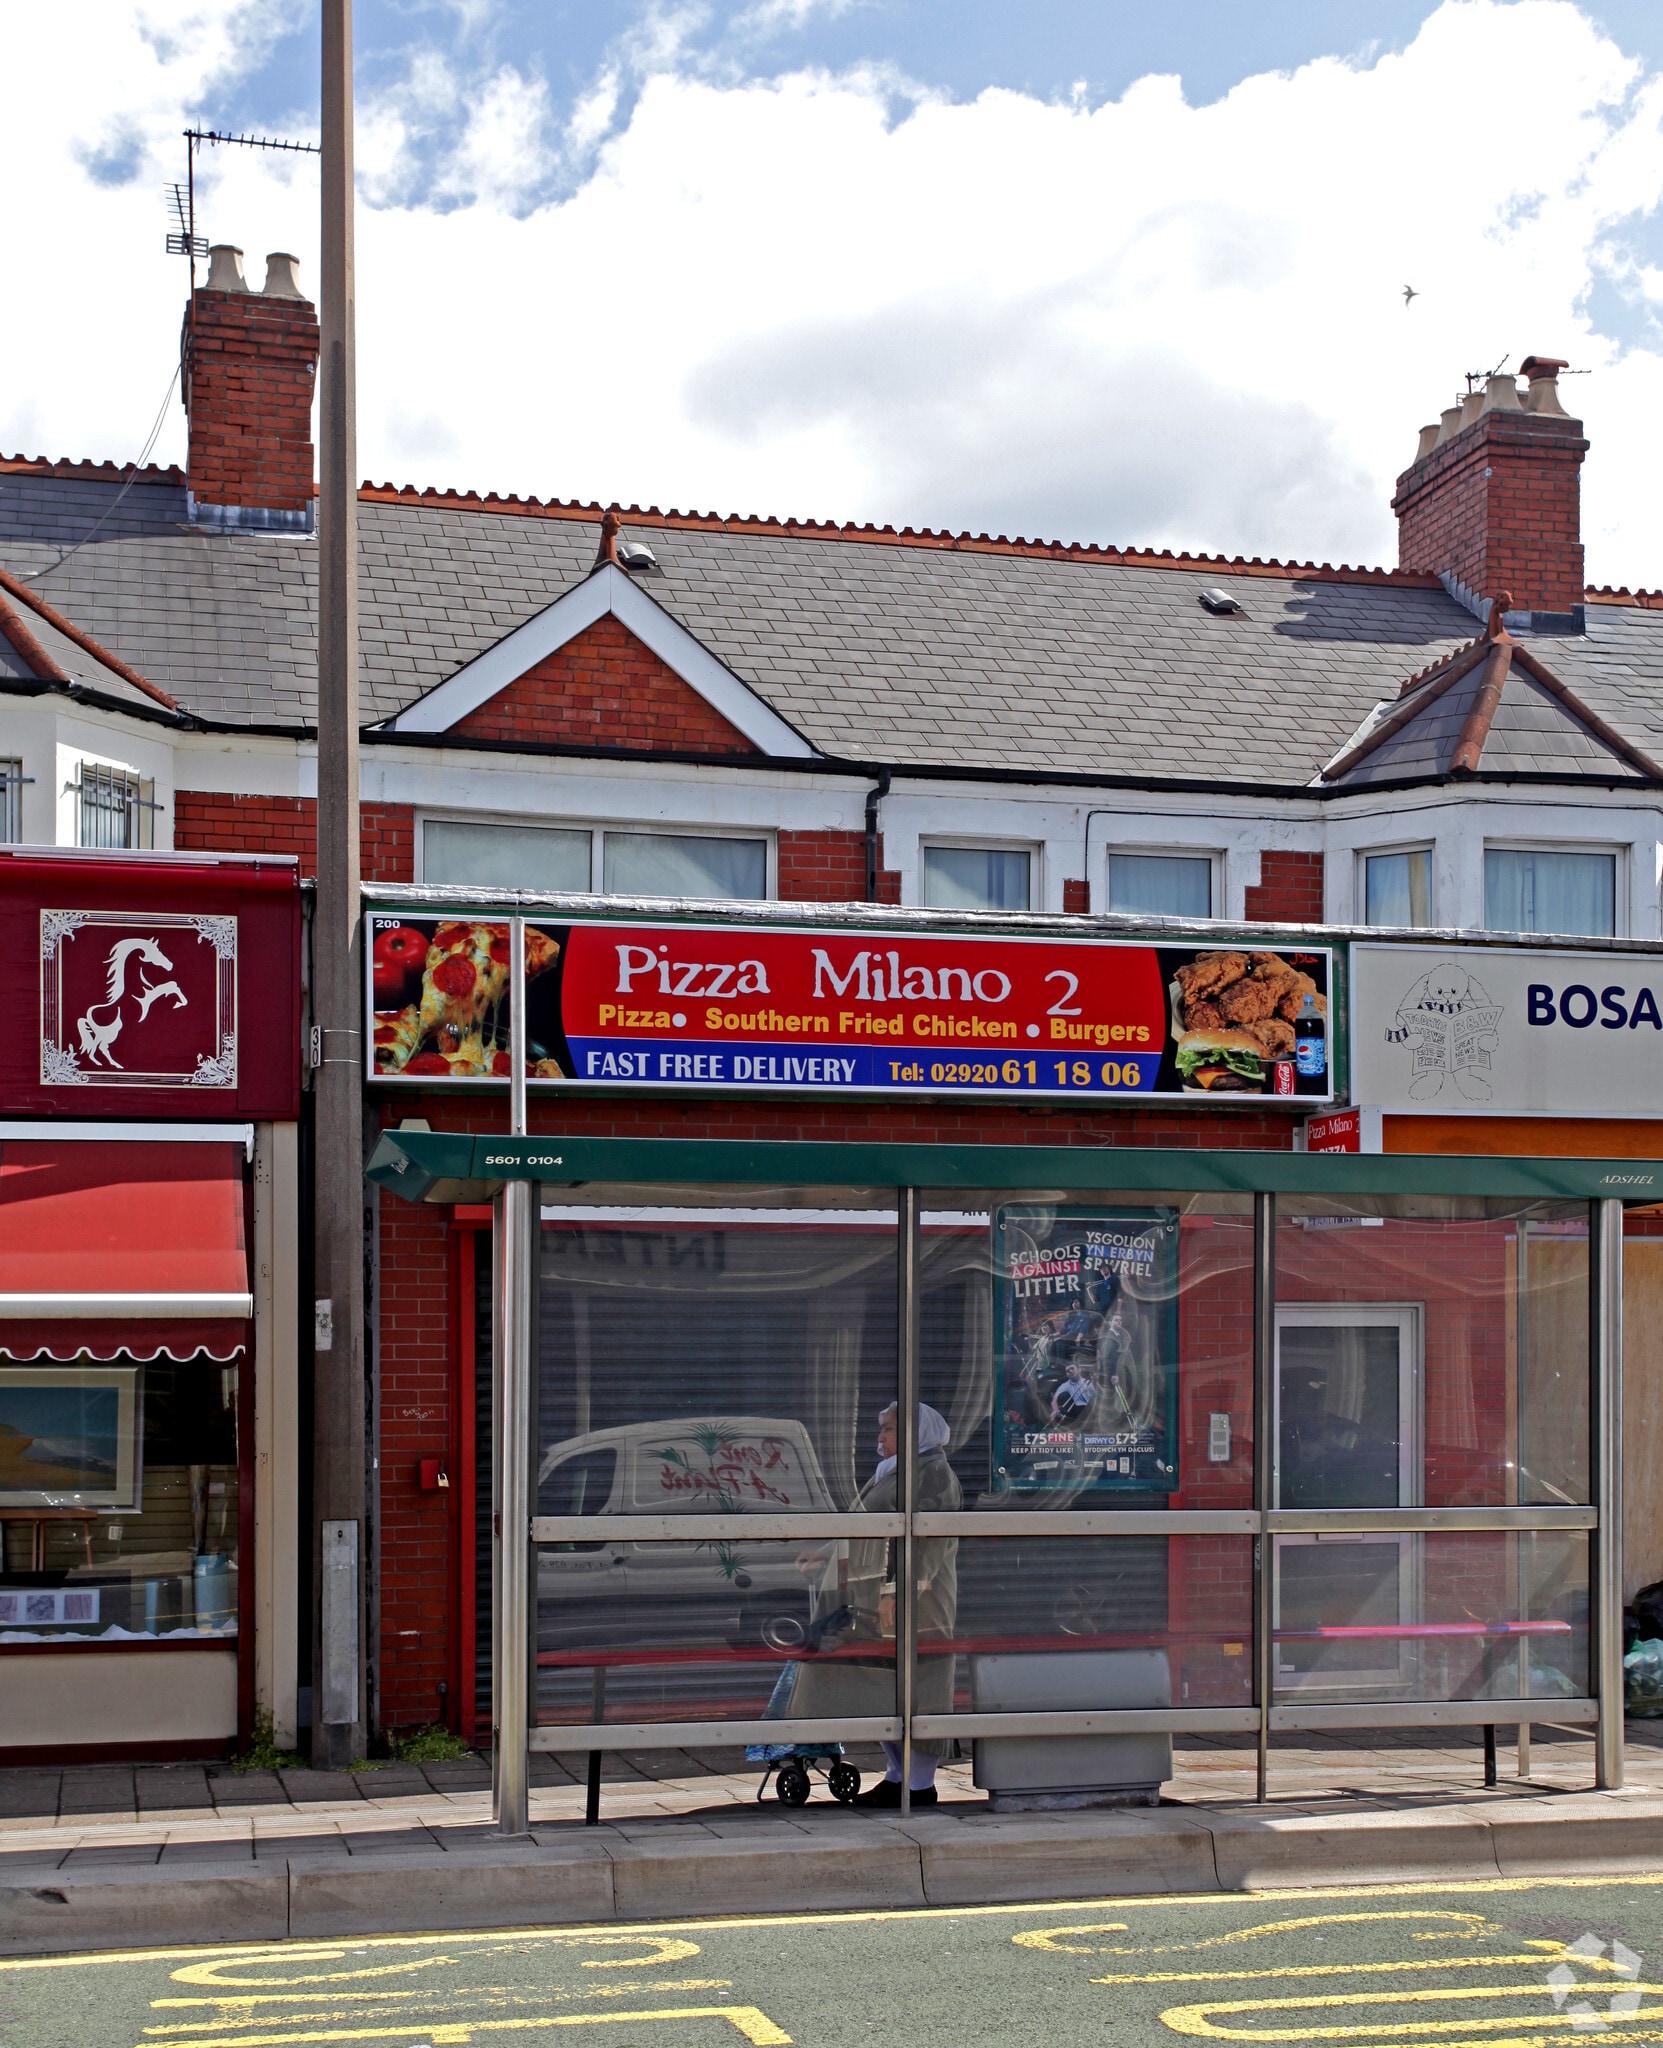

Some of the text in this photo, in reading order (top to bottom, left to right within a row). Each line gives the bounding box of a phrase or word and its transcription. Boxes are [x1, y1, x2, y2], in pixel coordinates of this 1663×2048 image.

[375, 919, 400, 929] 200
[615, 944, 1082, 1016] Pizza Milano 2
[1527, 984, 1662, 1030] BOSA
[599, 1004, 1150, 1045] Pizza Southern Fried Chicken Burgers
[1455, 1037, 1475, 1051] GREAT
[1455, 1046, 1475, 1058] NEWS
[587, 1052, 650, 1077] FAST
[660, 1053, 724, 1079] FREE
[734, 1056, 856, 1082] DELIVERY
[889, 1061, 925, 1082] Tel:
[1053, 1061, 1091, 1085] 18
[1101, 1062, 1140, 1086] 06
[1308, 1124, 1326, 1139] Pizza
[1328, 1117, 1353, 1135] Milano
[485, 1156, 563, 1165] 5601 0104
[1600, 1175, 1654, 1184] ADSHEL
[1086, 1231, 1155, 1250] YSGOLION
[1010, 1245, 1081, 1265] SCHOOLS
[1086, 1244, 1154, 1262] YN ERBYN
[1012, 1260, 1080, 1278] AGAINST
[1013, 1274, 1081, 1298] LITTER
[1024, 1433, 1047, 1445] £75
[1048, 1433, 1074, 1442] FINE
[1115, 1433, 1138, 1445] £75
